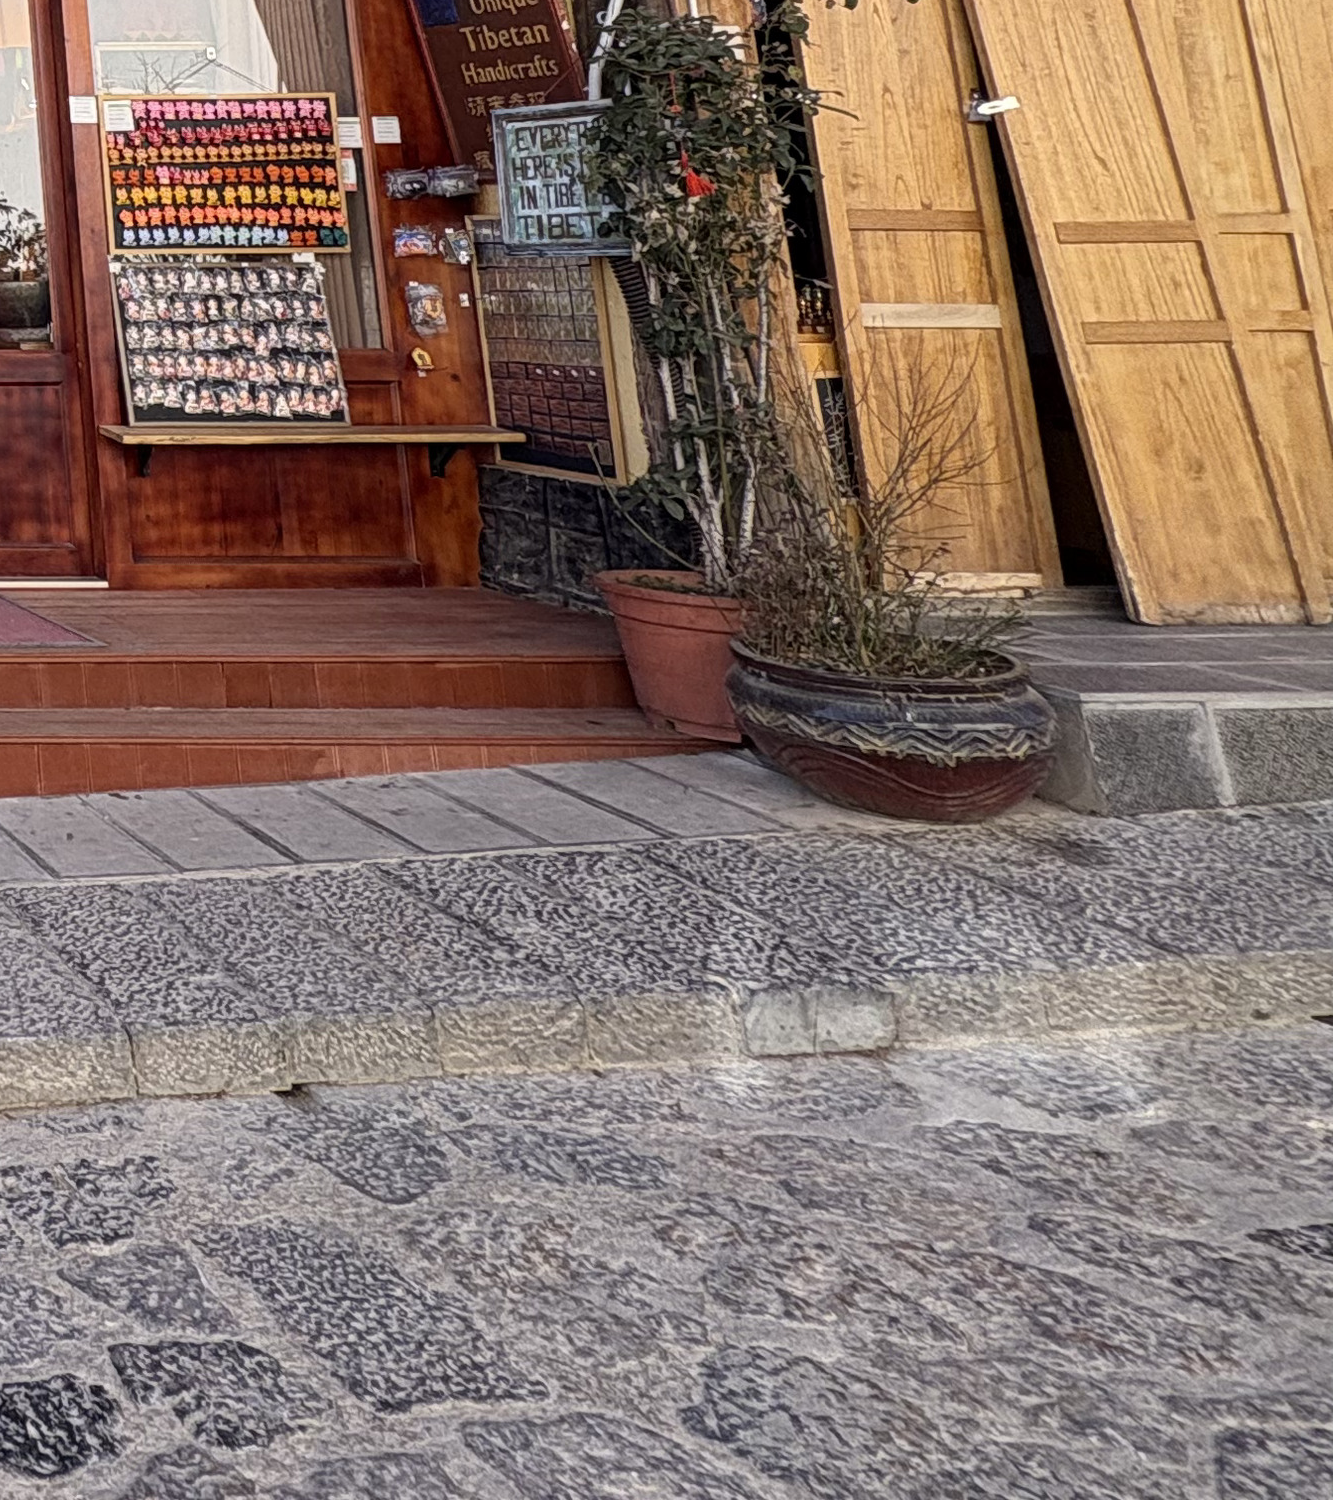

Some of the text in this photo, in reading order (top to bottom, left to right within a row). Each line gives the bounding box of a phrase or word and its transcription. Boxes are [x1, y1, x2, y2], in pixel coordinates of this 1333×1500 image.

[458, 22, 551, 53] Tibetan
[460, 54, 561, 86] Handicrafts
[512, 154, 555, 182] HERE
[519, 185, 539, 210] IN
